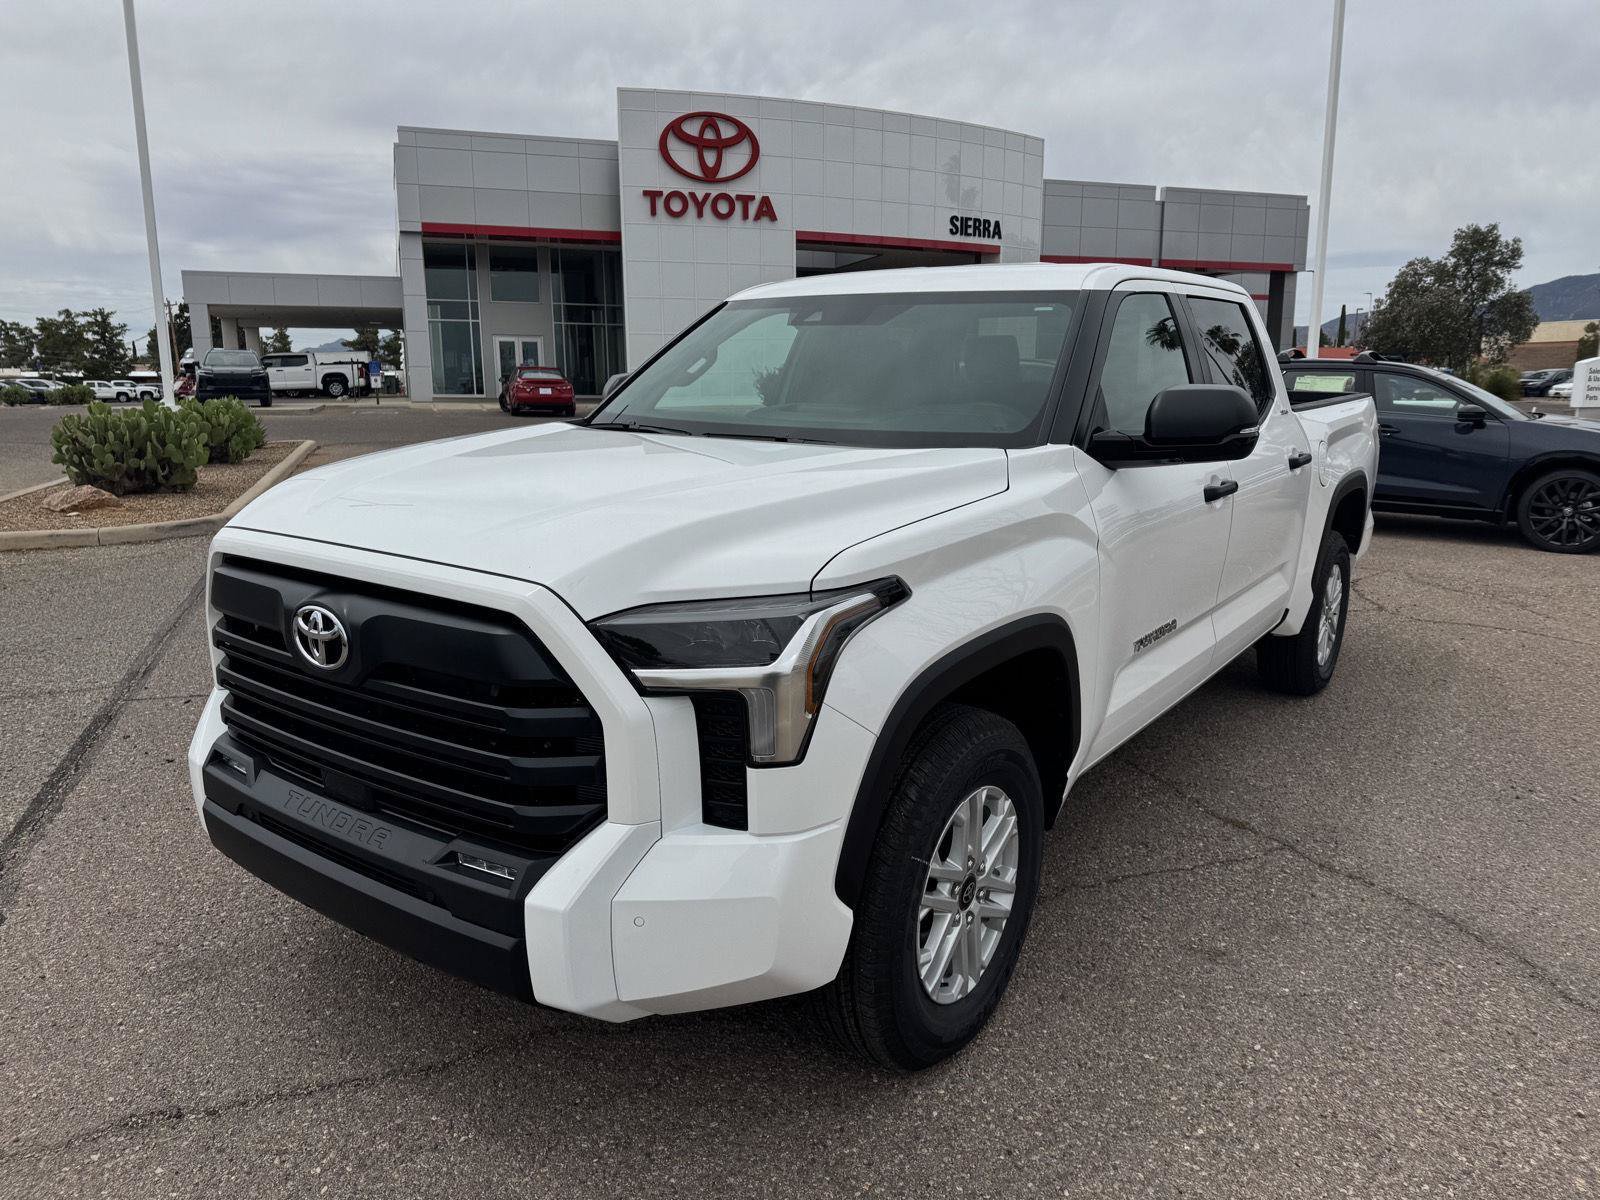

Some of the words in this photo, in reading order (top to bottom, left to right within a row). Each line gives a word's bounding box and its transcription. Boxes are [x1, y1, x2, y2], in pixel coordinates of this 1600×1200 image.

[642, 190, 778, 221] TOYOTA
[949, 215, 1002, 239] SIERRA
[284, 789, 392, 850] TUNDRA
